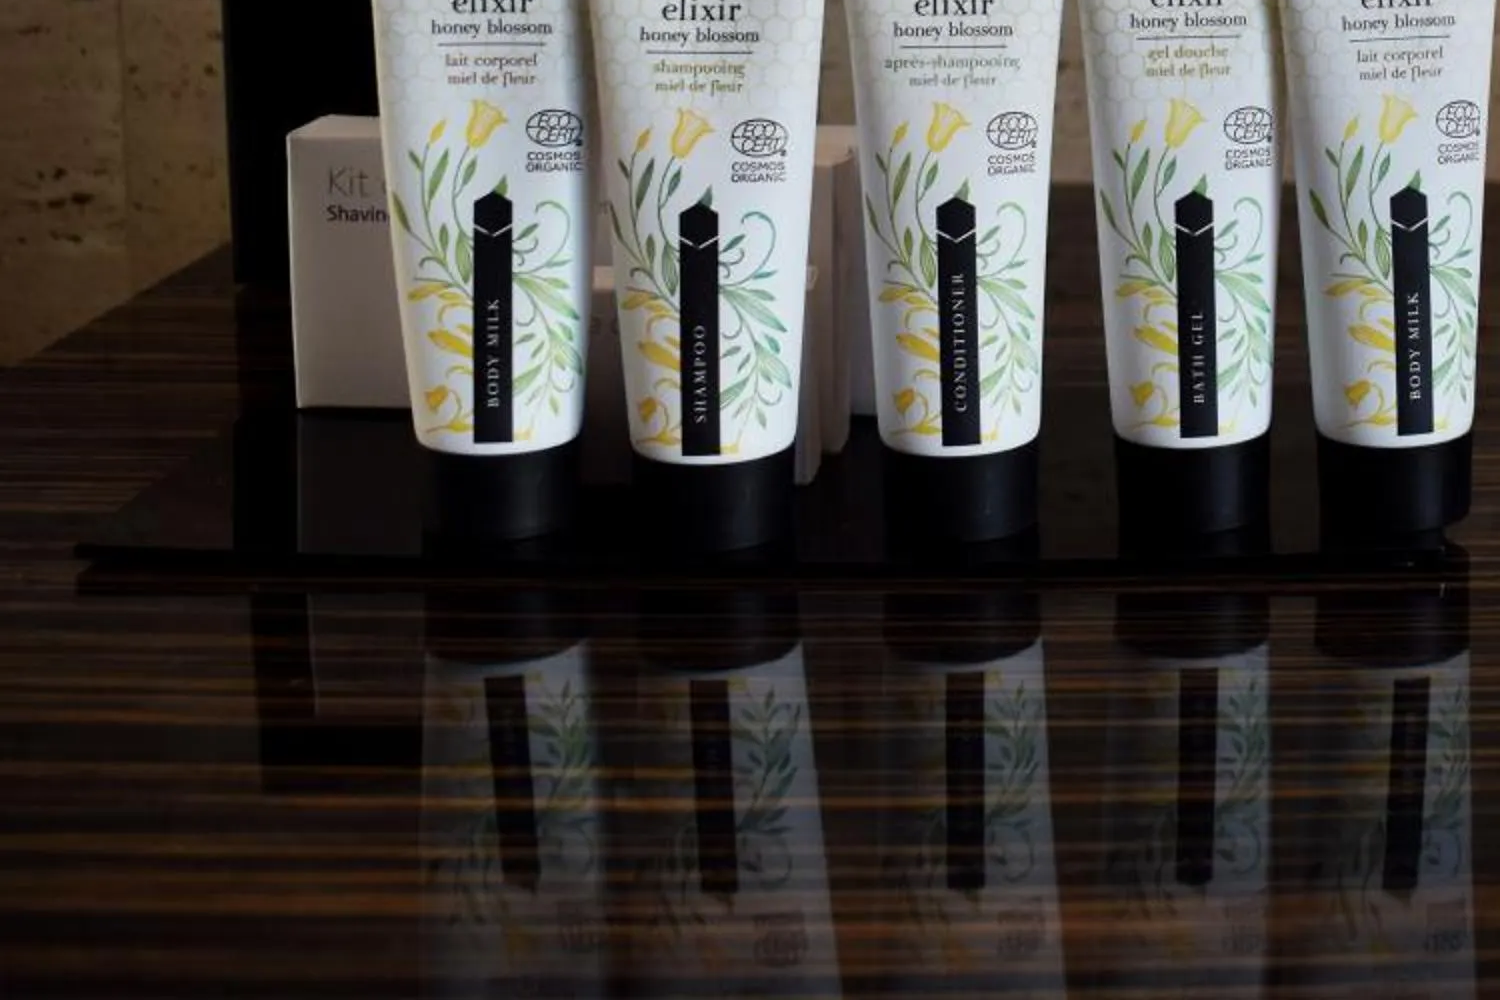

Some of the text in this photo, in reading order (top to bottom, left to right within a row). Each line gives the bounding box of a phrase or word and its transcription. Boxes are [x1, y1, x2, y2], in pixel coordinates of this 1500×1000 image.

[431, 19, 552, 38] honey blossom
[893, 21, 1013, 41] honey blossom
[1129, 12, 1247, 32] honey blossom
[1341, 14, 1456, 34] honey blossom
[640, 26, 759, 48] honey blossom
[445, 52, 537, 70] lait corporel
[1147, 44, 1229, 61] gel douche
[1357, 46, 1444, 65] lait corporel
[653, 60, 745, 78] shampooing
[527, 151, 580, 161] COSMOS
[987, 152, 1035, 164] COSMOS
[1225, 148, 1271, 159] COSMOS
[732, 161, 785, 172] COSMOS
[328, 166, 371, 198] Kit
[326, 204, 390, 224] Shavin
[951, 273, 968, 412] CONDITIONER
[1407, 291, 1421, 399] BODY MILK
[486, 299, 499, 407] BODY MILK
[1190, 312, 1205, 403] BATH GEL
[693, 325, 707, 424] SHAMPOO
